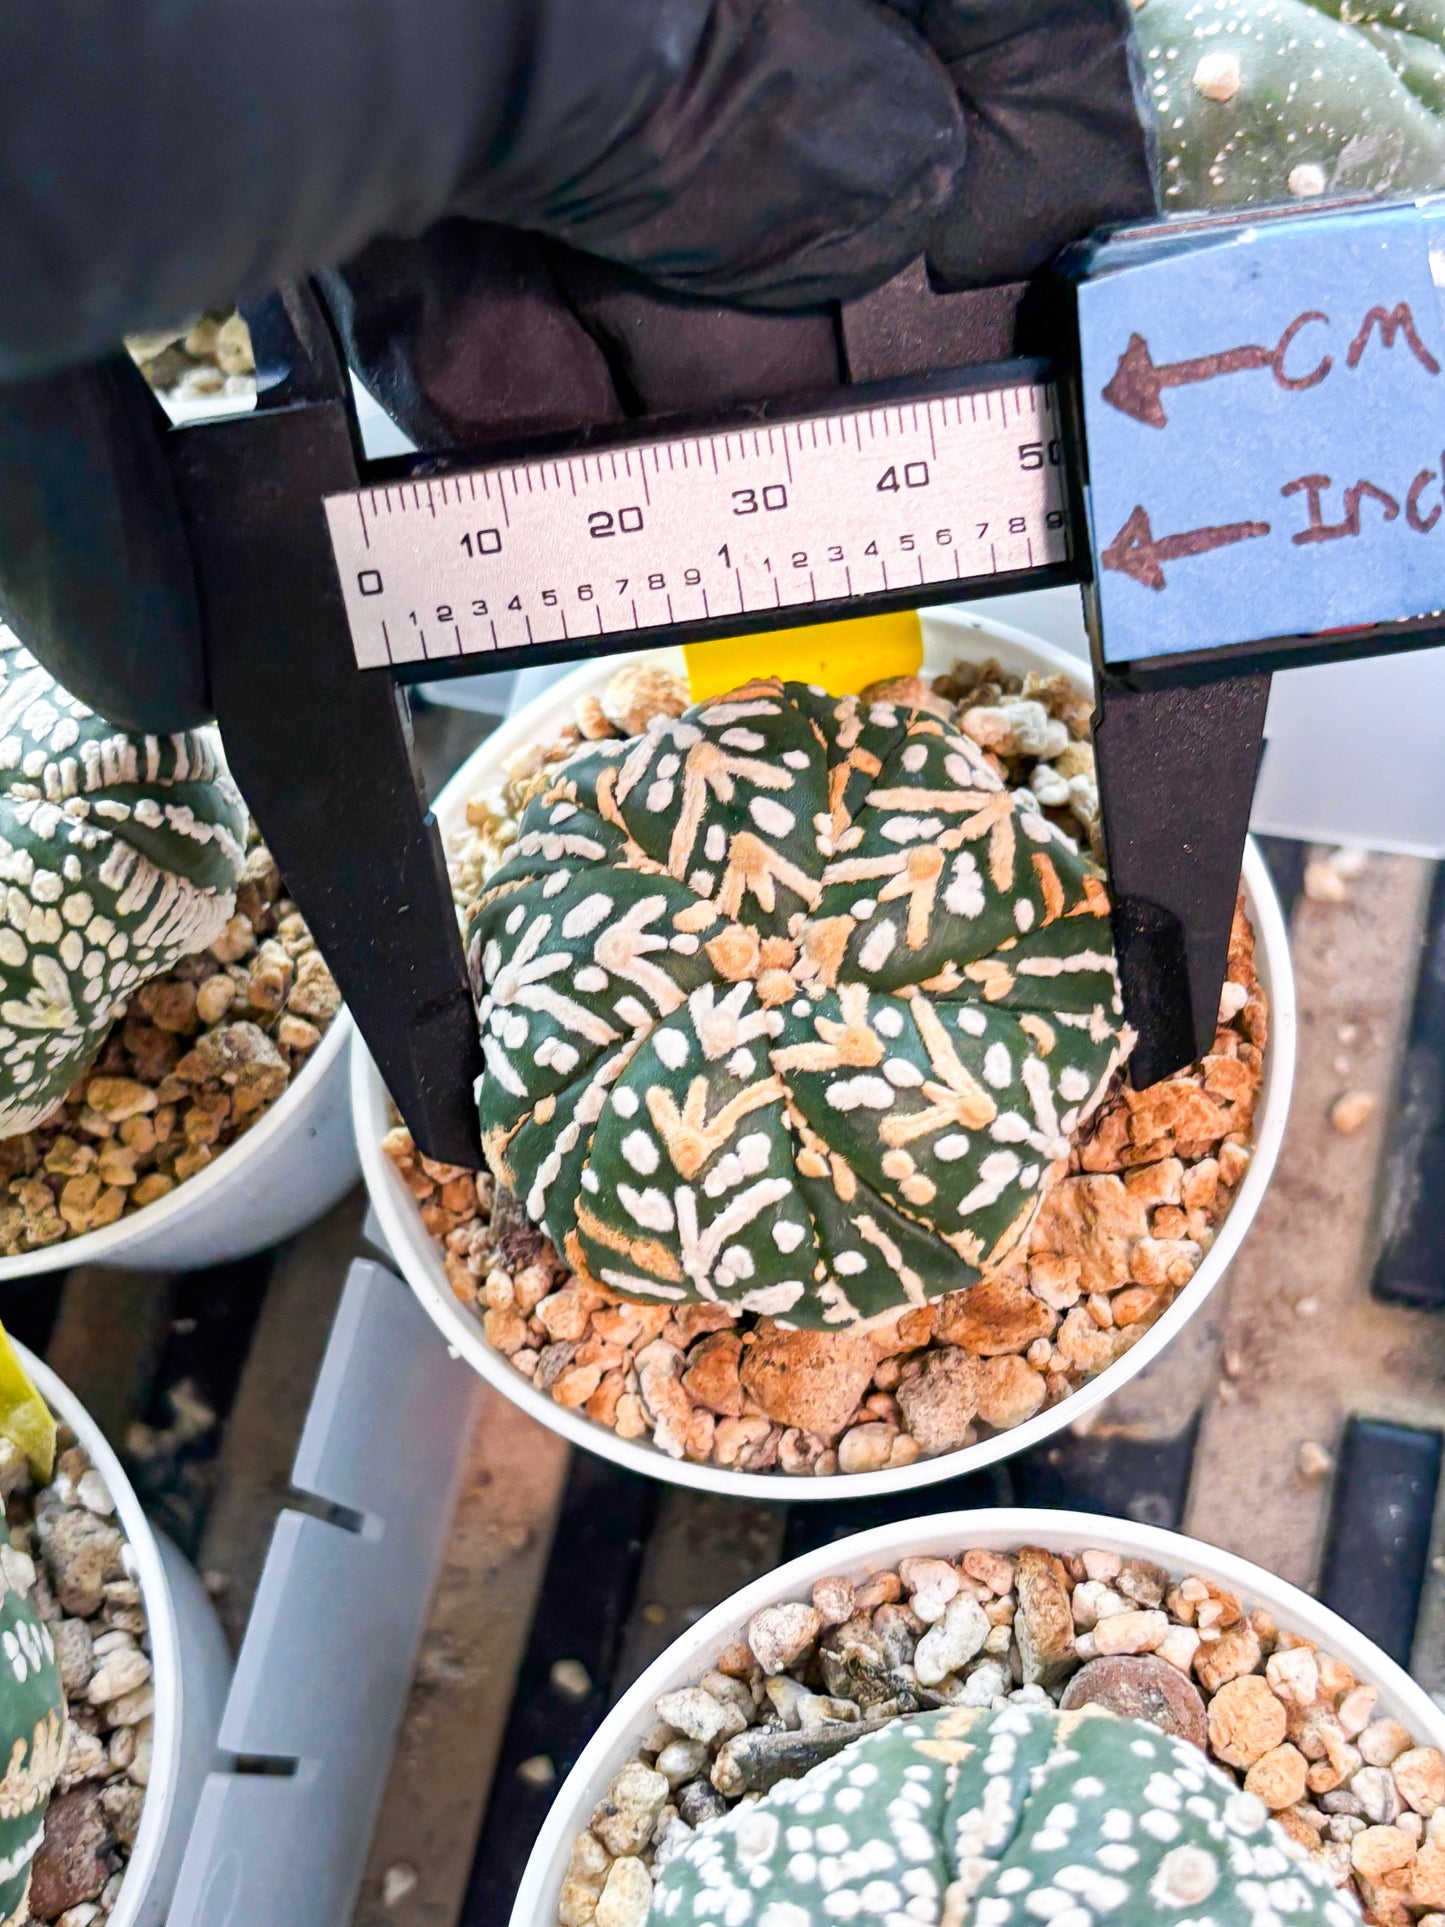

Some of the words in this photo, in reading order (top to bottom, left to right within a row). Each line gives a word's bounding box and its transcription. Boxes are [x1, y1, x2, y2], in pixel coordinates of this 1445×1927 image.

[1272, 302, 1440, 391] CM
[357, 569, 384, 597] 0
[459, 528, 503, 558] 10
[587, 506, 645, 539] 20
[731, 484, 789, 516] 30
[876, 461, 930, 493] 40
[1280, 449, 1445, 545] Inc
[408, 610, 418, 627] 1
[435, 604, 454, 623] 2
[471, 599, 489, 617] 3
[507, 594, 523, 612] 4
[541, 589, 558, 607] 5
[577, 583, 594, 602] 6
[615, 578, 629, 596] 7
[647, 573, 666, 590] 8
[684, 568, 701, 586] 9
[717, 543, 731, 569] 1
[762, 557, 772, 574] 1
[791, 551, 808, 569] 2
[828, 546, 844, 562] 3
[864, 540, 879, 557] 4
[900, 534, 915, 552] 5
[936, 528, 952, 546] 6
[975, 522, 989, 540] 7
[1008, 516, 1027, 534] 8
